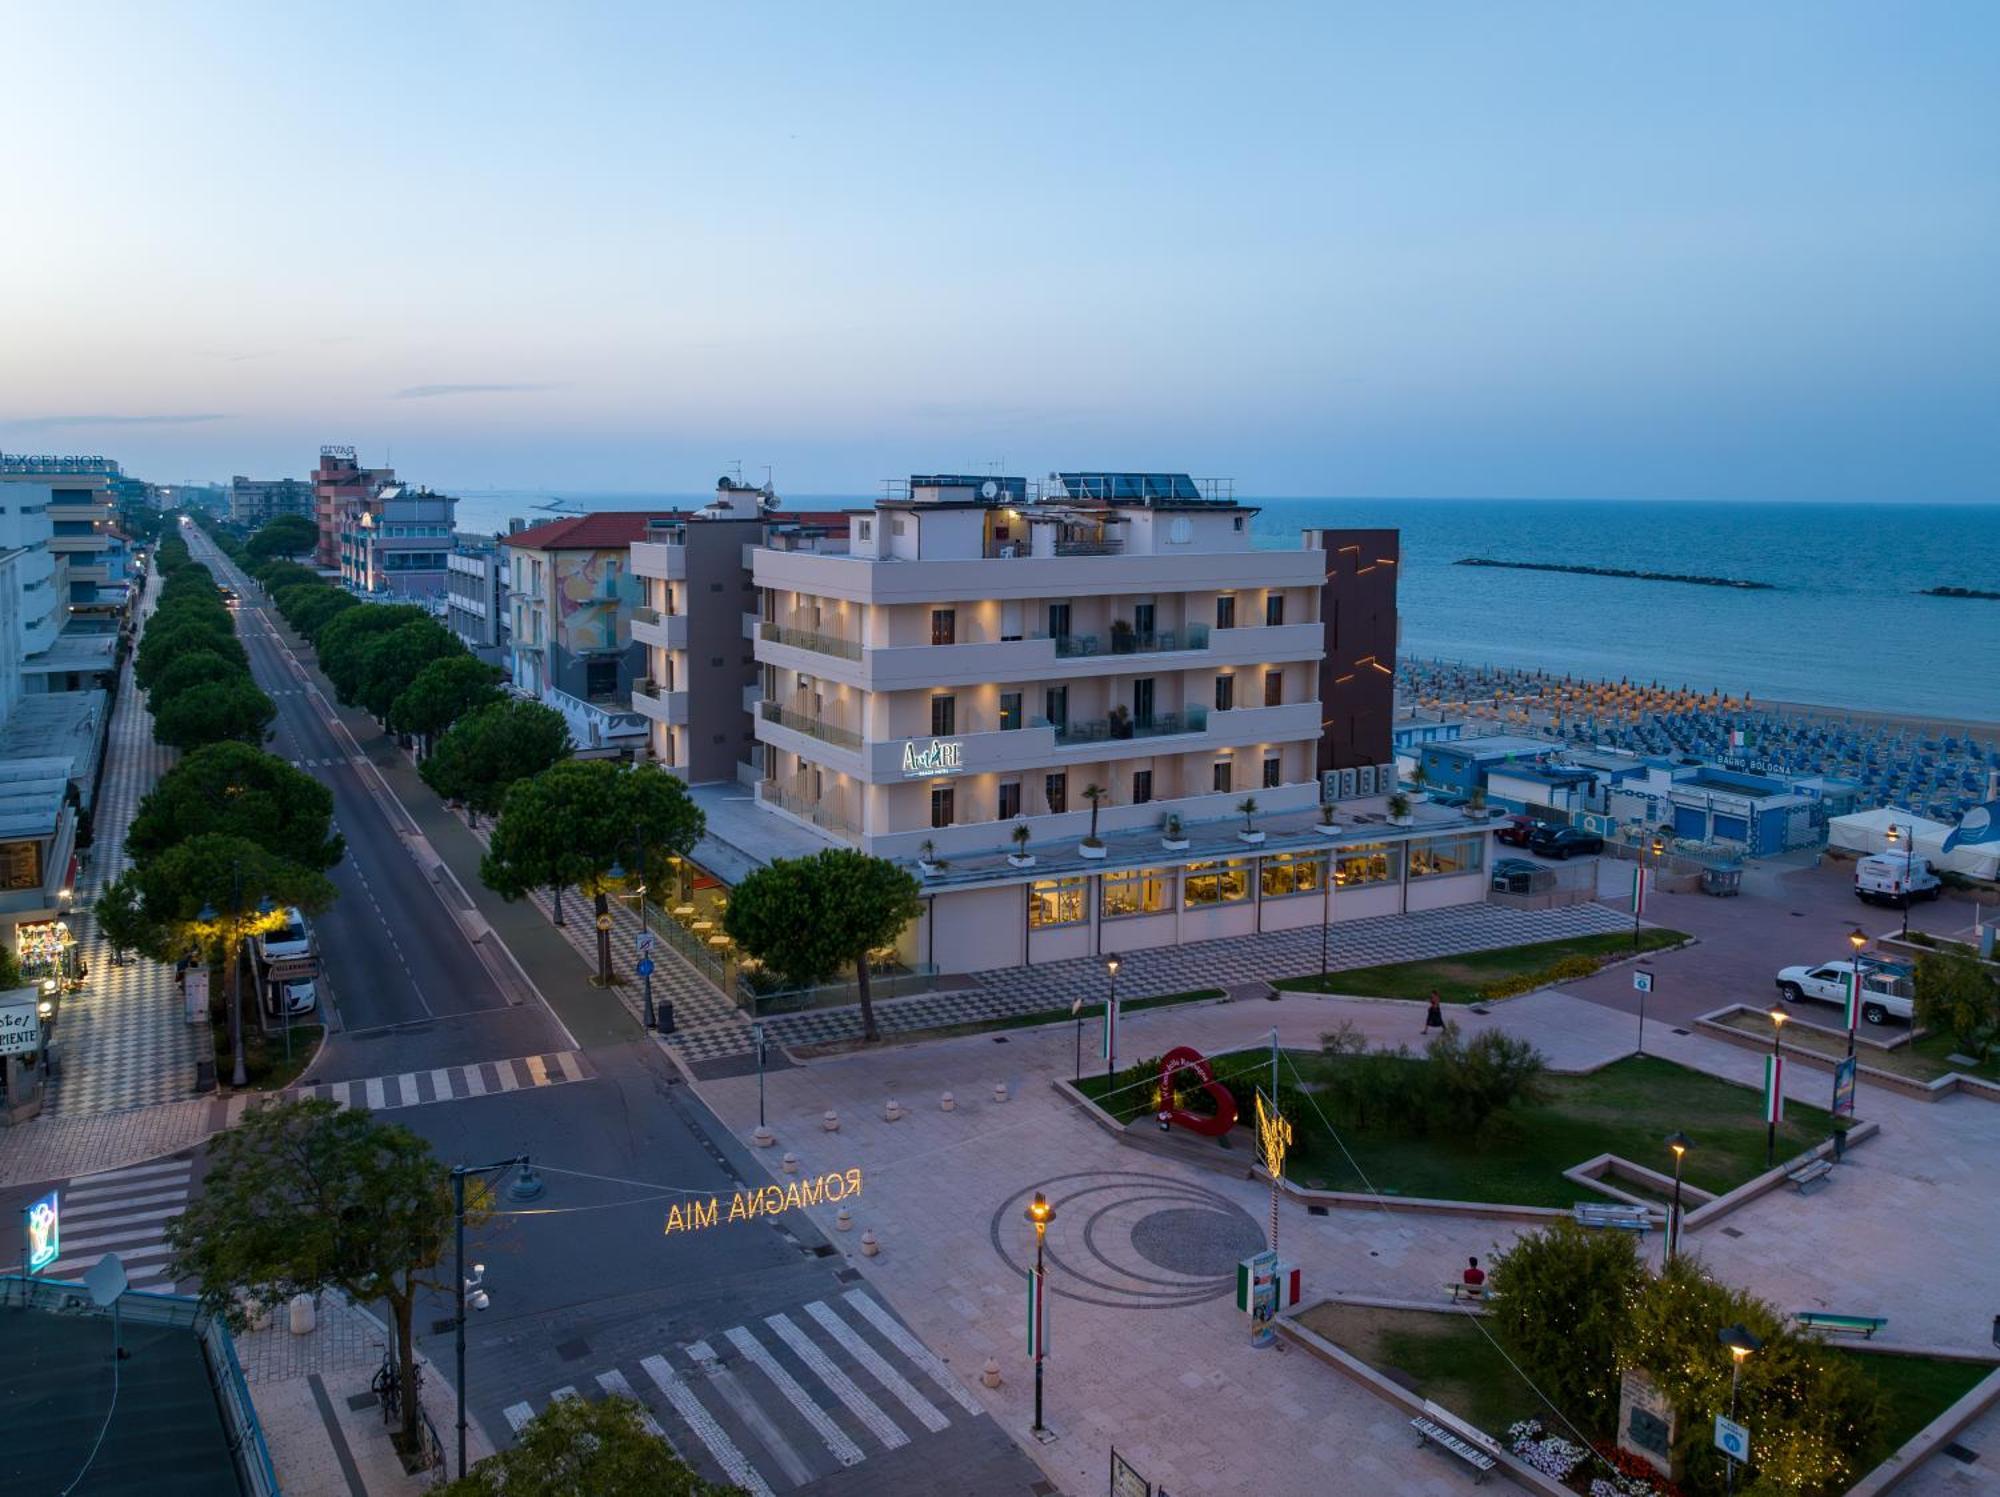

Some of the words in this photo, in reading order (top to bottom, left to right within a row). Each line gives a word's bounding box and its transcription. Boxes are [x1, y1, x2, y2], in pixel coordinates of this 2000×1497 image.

[4, 455, 104, 466] EXCELSIOR
[1717, 755, 1746, 767] BAGNO
[1750, 760, 1792, 775] BOLOGNA
